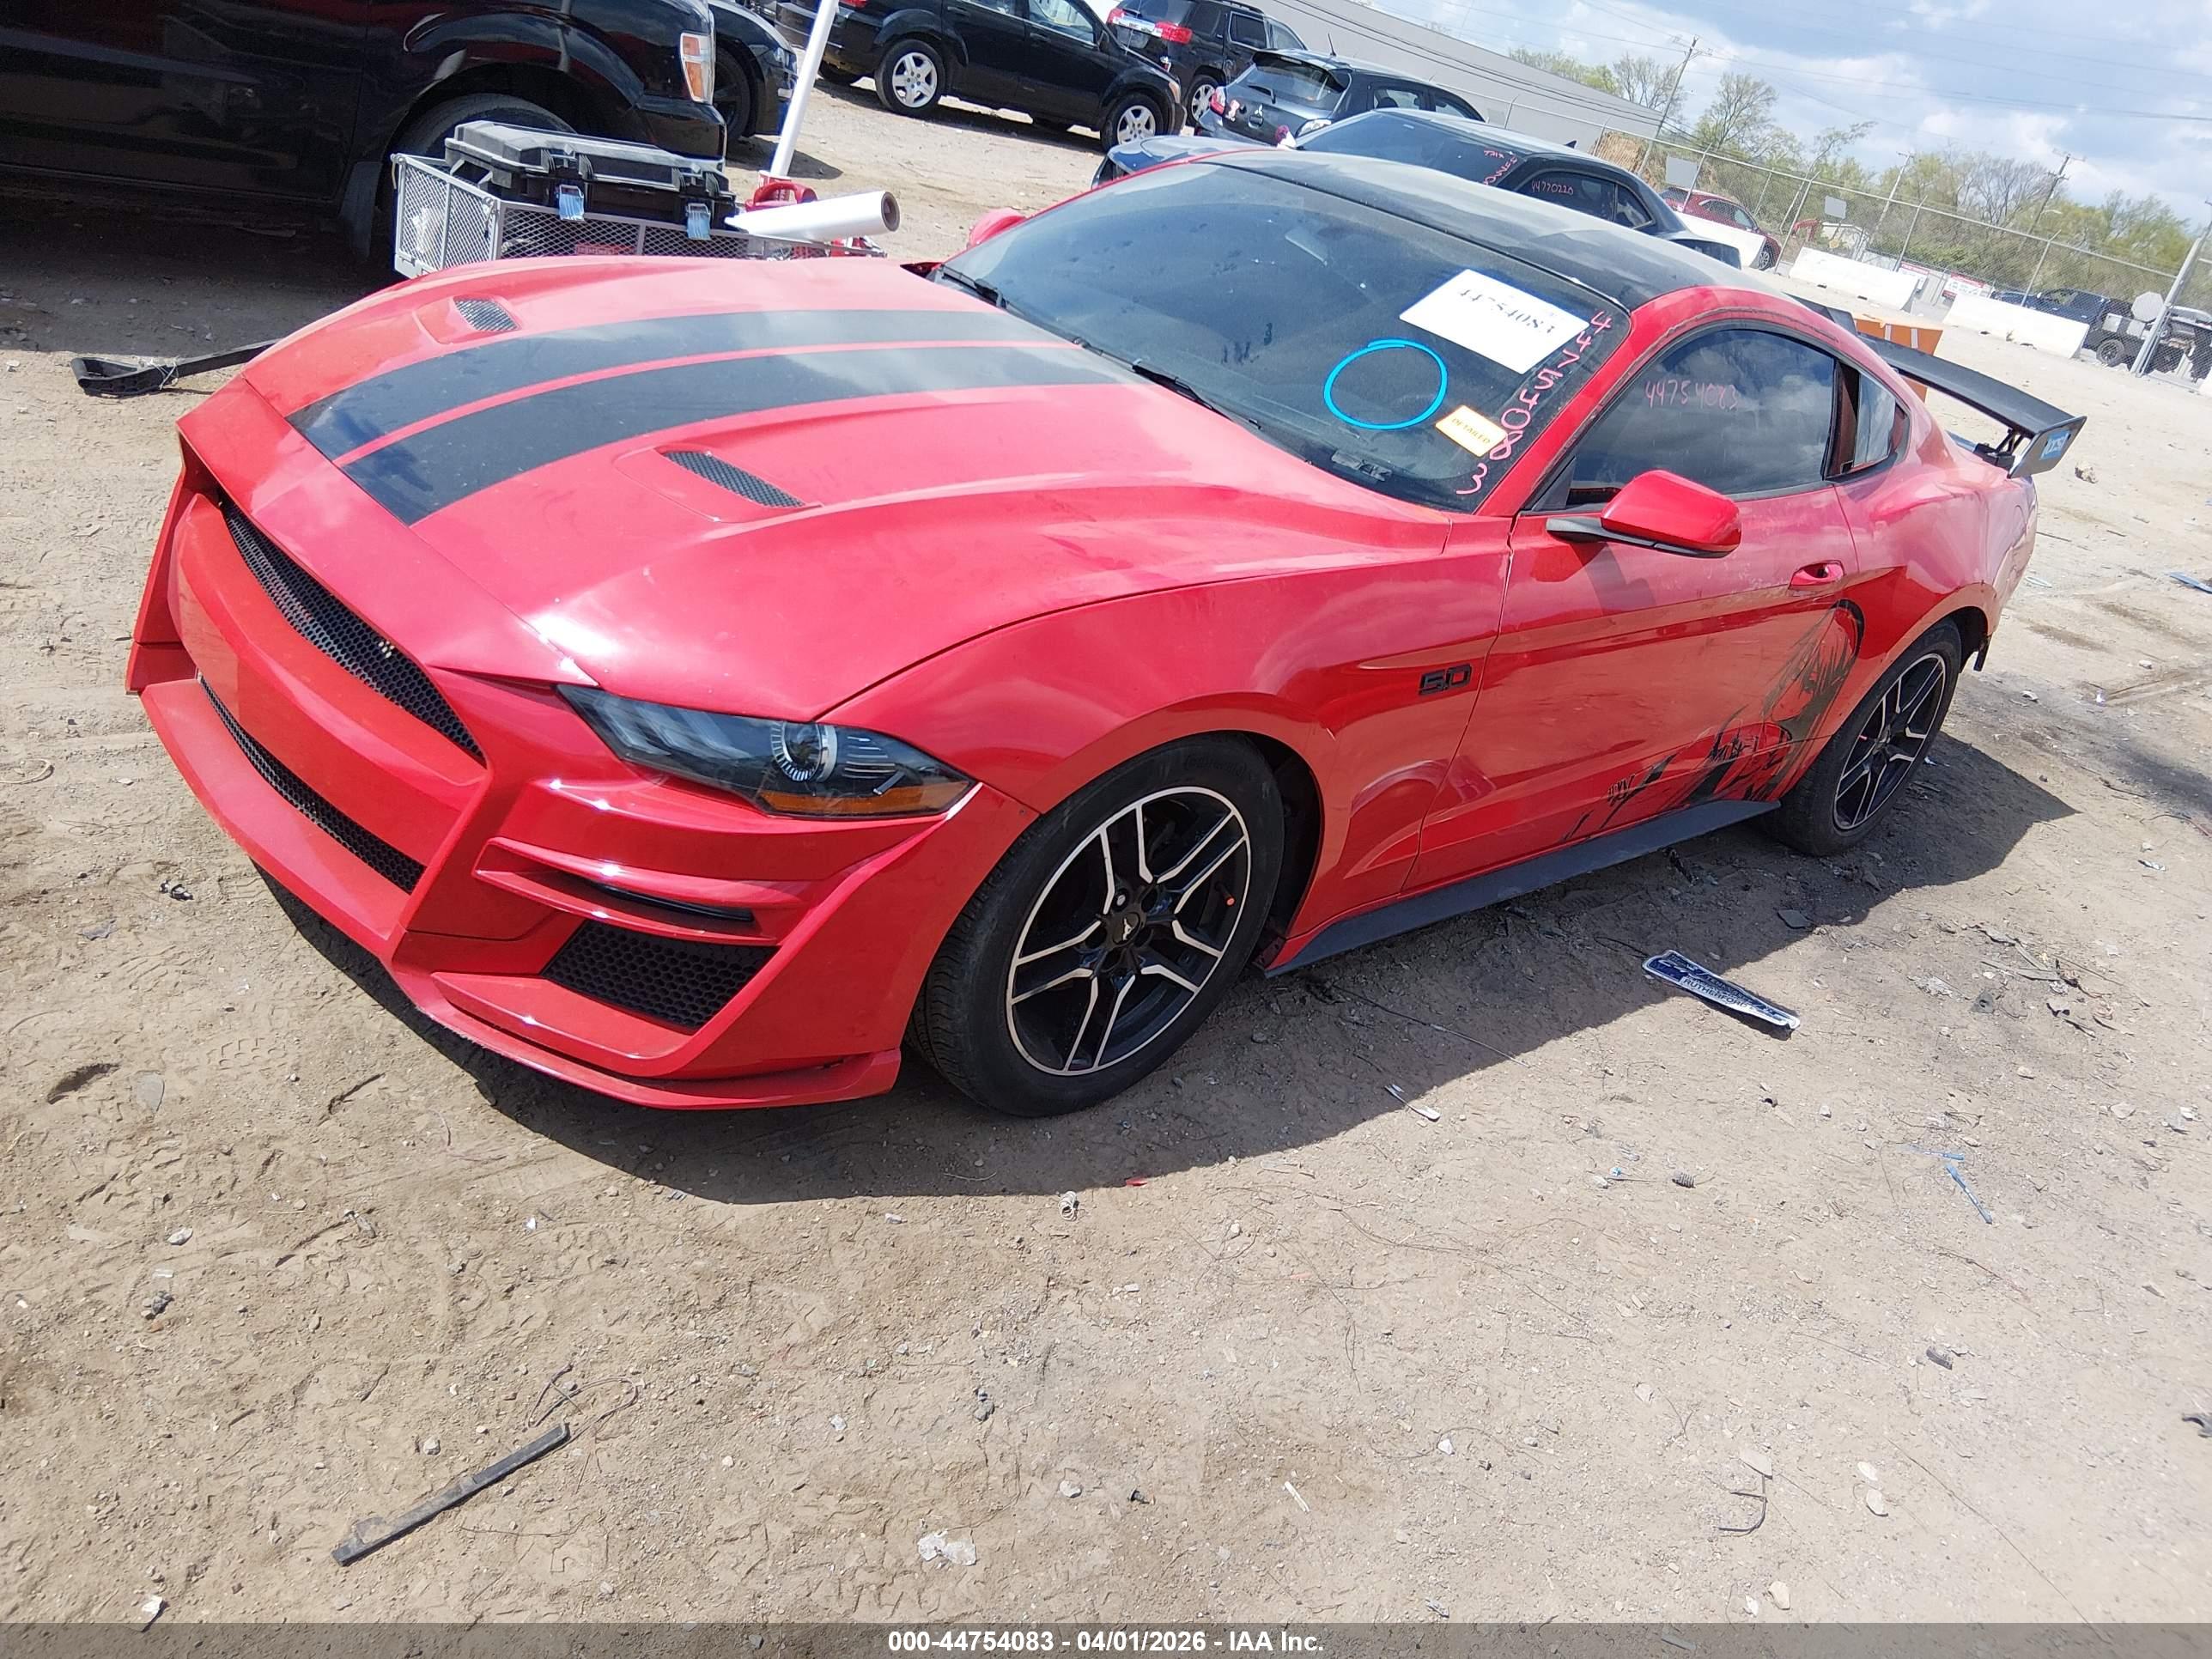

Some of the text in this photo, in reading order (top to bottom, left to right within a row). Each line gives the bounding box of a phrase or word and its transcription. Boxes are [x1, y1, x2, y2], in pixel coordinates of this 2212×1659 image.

[1531, 179, 1574, 196] 44770220
[1455, 310, 1613, 495] 44754083
[1681, 976, 1749, 1009] RUTHERFORD
